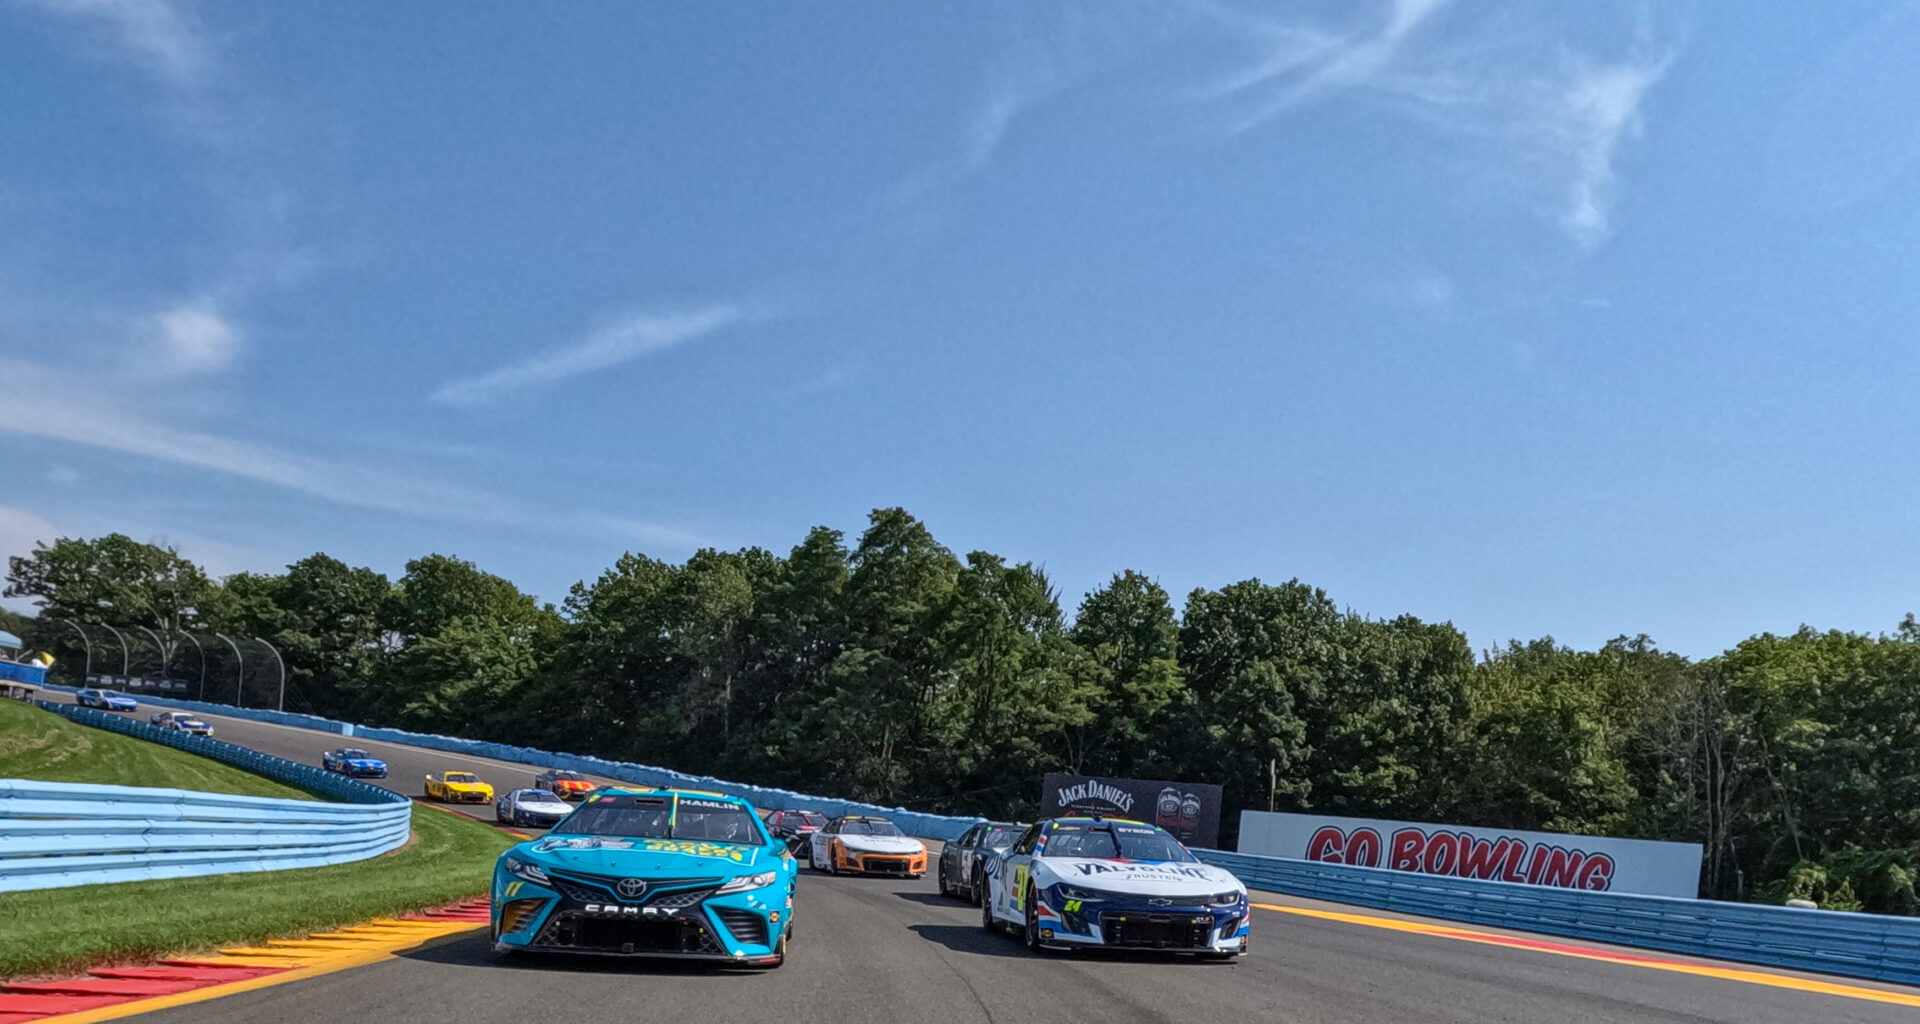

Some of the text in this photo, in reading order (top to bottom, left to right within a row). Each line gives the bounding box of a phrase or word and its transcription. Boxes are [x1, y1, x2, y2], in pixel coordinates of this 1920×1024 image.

[1058, 780, 1087, 807] JACK
[1088, 780, 1134, 813] DANIEL'S
[680, 799, 740, 810] HAMLIN
[1118, 827, 1155, 835] BYRON
[1306, 826, 1615, 892] GO BOWLING
[585, 904, 679, 915] CAMRY
[1064, 900, 1082, 912] 24
